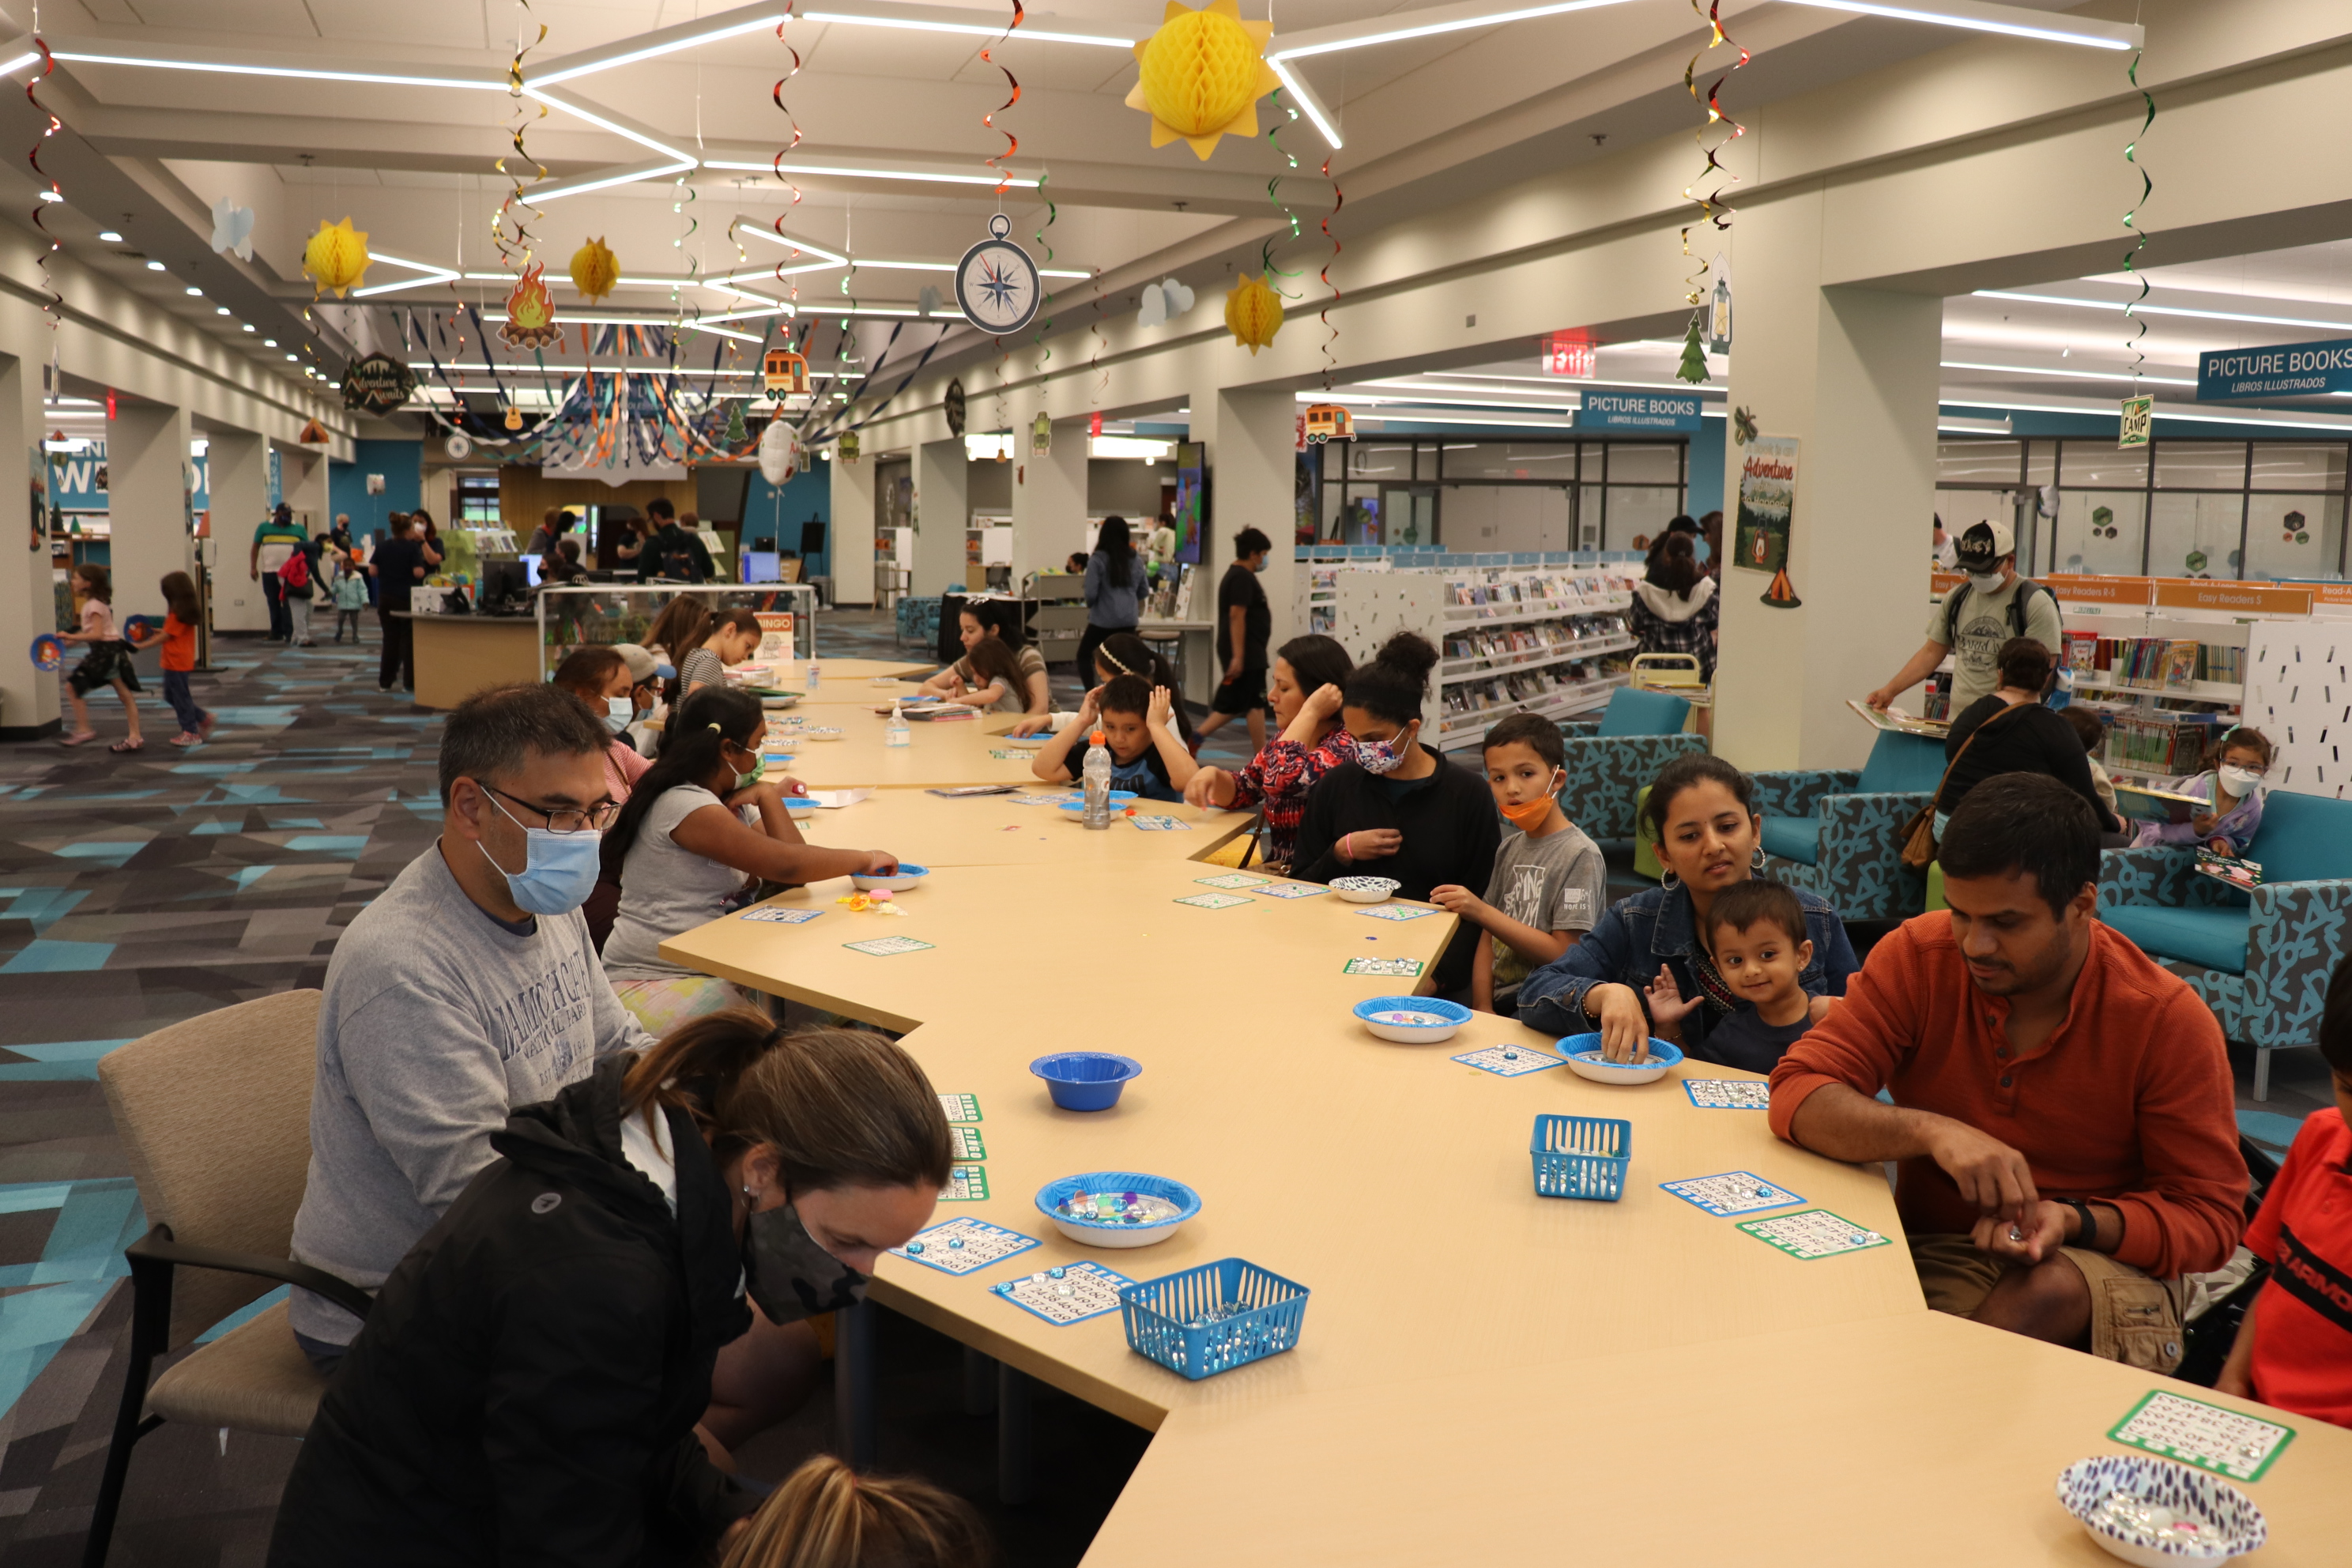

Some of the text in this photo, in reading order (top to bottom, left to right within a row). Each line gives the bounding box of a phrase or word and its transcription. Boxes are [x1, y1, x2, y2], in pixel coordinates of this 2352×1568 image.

[2208, 349, 2352, 378] PICTURE BOOKS
[2231, 377, 2326, 393] LIBROS ILLUSTRADOS
[1589, 396, 1694, 416] PICTURE BOOKS
[1608, 416, 1676, 427] LIBROS ILLUSTRADOS
[2124, 413, 2147, 436] CAMP
[1743, 454, 1793, 481] Adventure
[2055, 586, 2116, 597] Easy Readers R-S
[2198, 592, 2262, 605] Easy Readers S
[958, 1094, 979, 1121] BINGO
[963, 1128, 982, 1158] BINGO
[965, 1166, 985, 1198] BINGO
[1663, 1183, 1728, 1214] BINGO
[957, 1218, 1036, 1245] BINGO
[1740, 1223, 1814, 1258] BINGO
[1090, 1279, 1110, 1287] 36
[2288, 1257, 2352, 1314] ARMO
[1030, 1287, 1048, 1295] 24
[1042, 1293, 1061, 1302] 38
[1055, 1300, 1074, 1309] 46
[1069, 1307, 1087, 1316] 64
[1072, 1295, 1103, 1310] 49 61
[1087, 1291, 1106, 1299] 60
[1101, 1297, 1121, 1306] 75
[1038, 1305, 1057, 1314] 57
[1052, 1312, 1071, 1321] 69
[2184, 1432, 2207, 1442] 40
[2258, 1425, 2281, 1434] 14
[2113, 1431, 2252, 1478] BINGO
